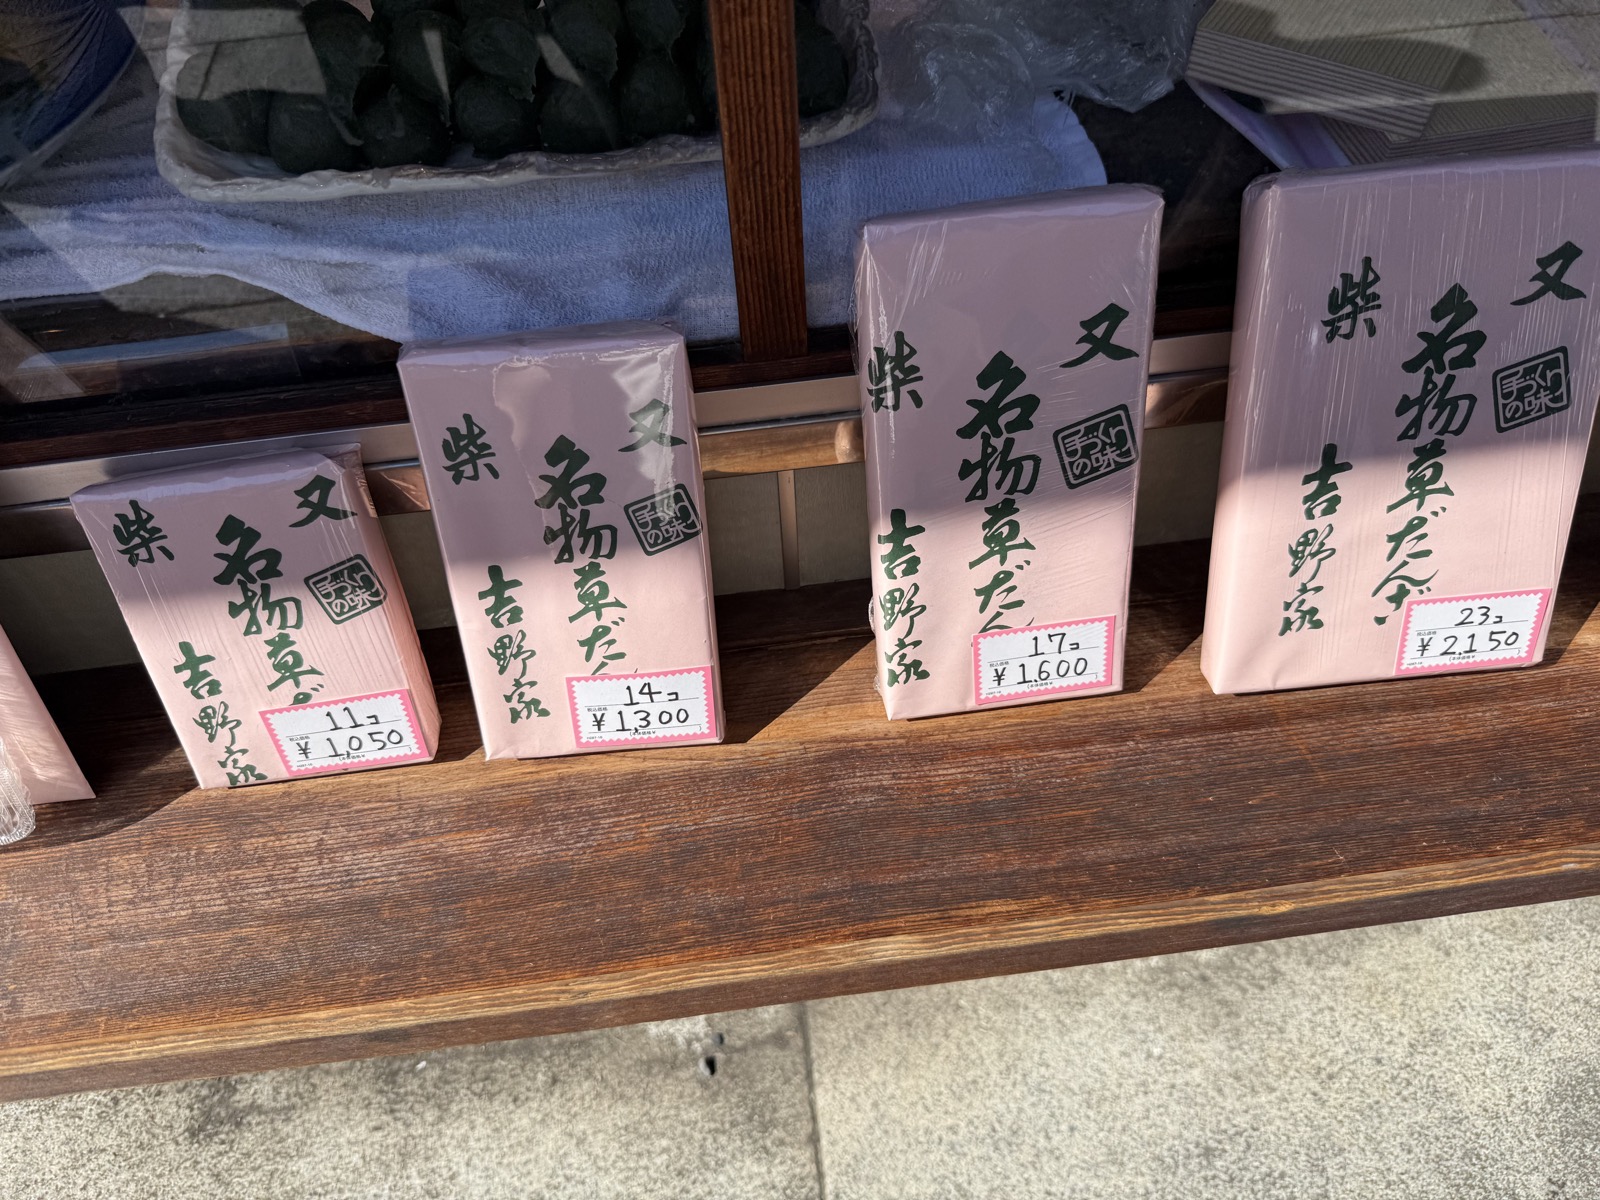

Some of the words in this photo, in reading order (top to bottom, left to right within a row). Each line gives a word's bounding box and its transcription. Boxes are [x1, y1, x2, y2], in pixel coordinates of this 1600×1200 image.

[1321, 256, 1382, 344] 柴
[1509, 240, 1587, 306] 又
[866, 331, 924, 413] 柴
[1059, 303, 1140, 369] 又
[442, 413, 500, 485] 柴
[618, 398, 687, 453] 又
[113, 500, 174, 567] 柴
[289, 475, 357, 528] 又
[1278, 444, 1353, 637] 吉野家
[534, 434, 638, 676] 名物草だ
[213, 514, 324, 706] 名物草
[877, 509, 930, 688] 吉野家
[478, 565, 551, 723] 吉野家
[174, 641, 268, 786] 吉野家
